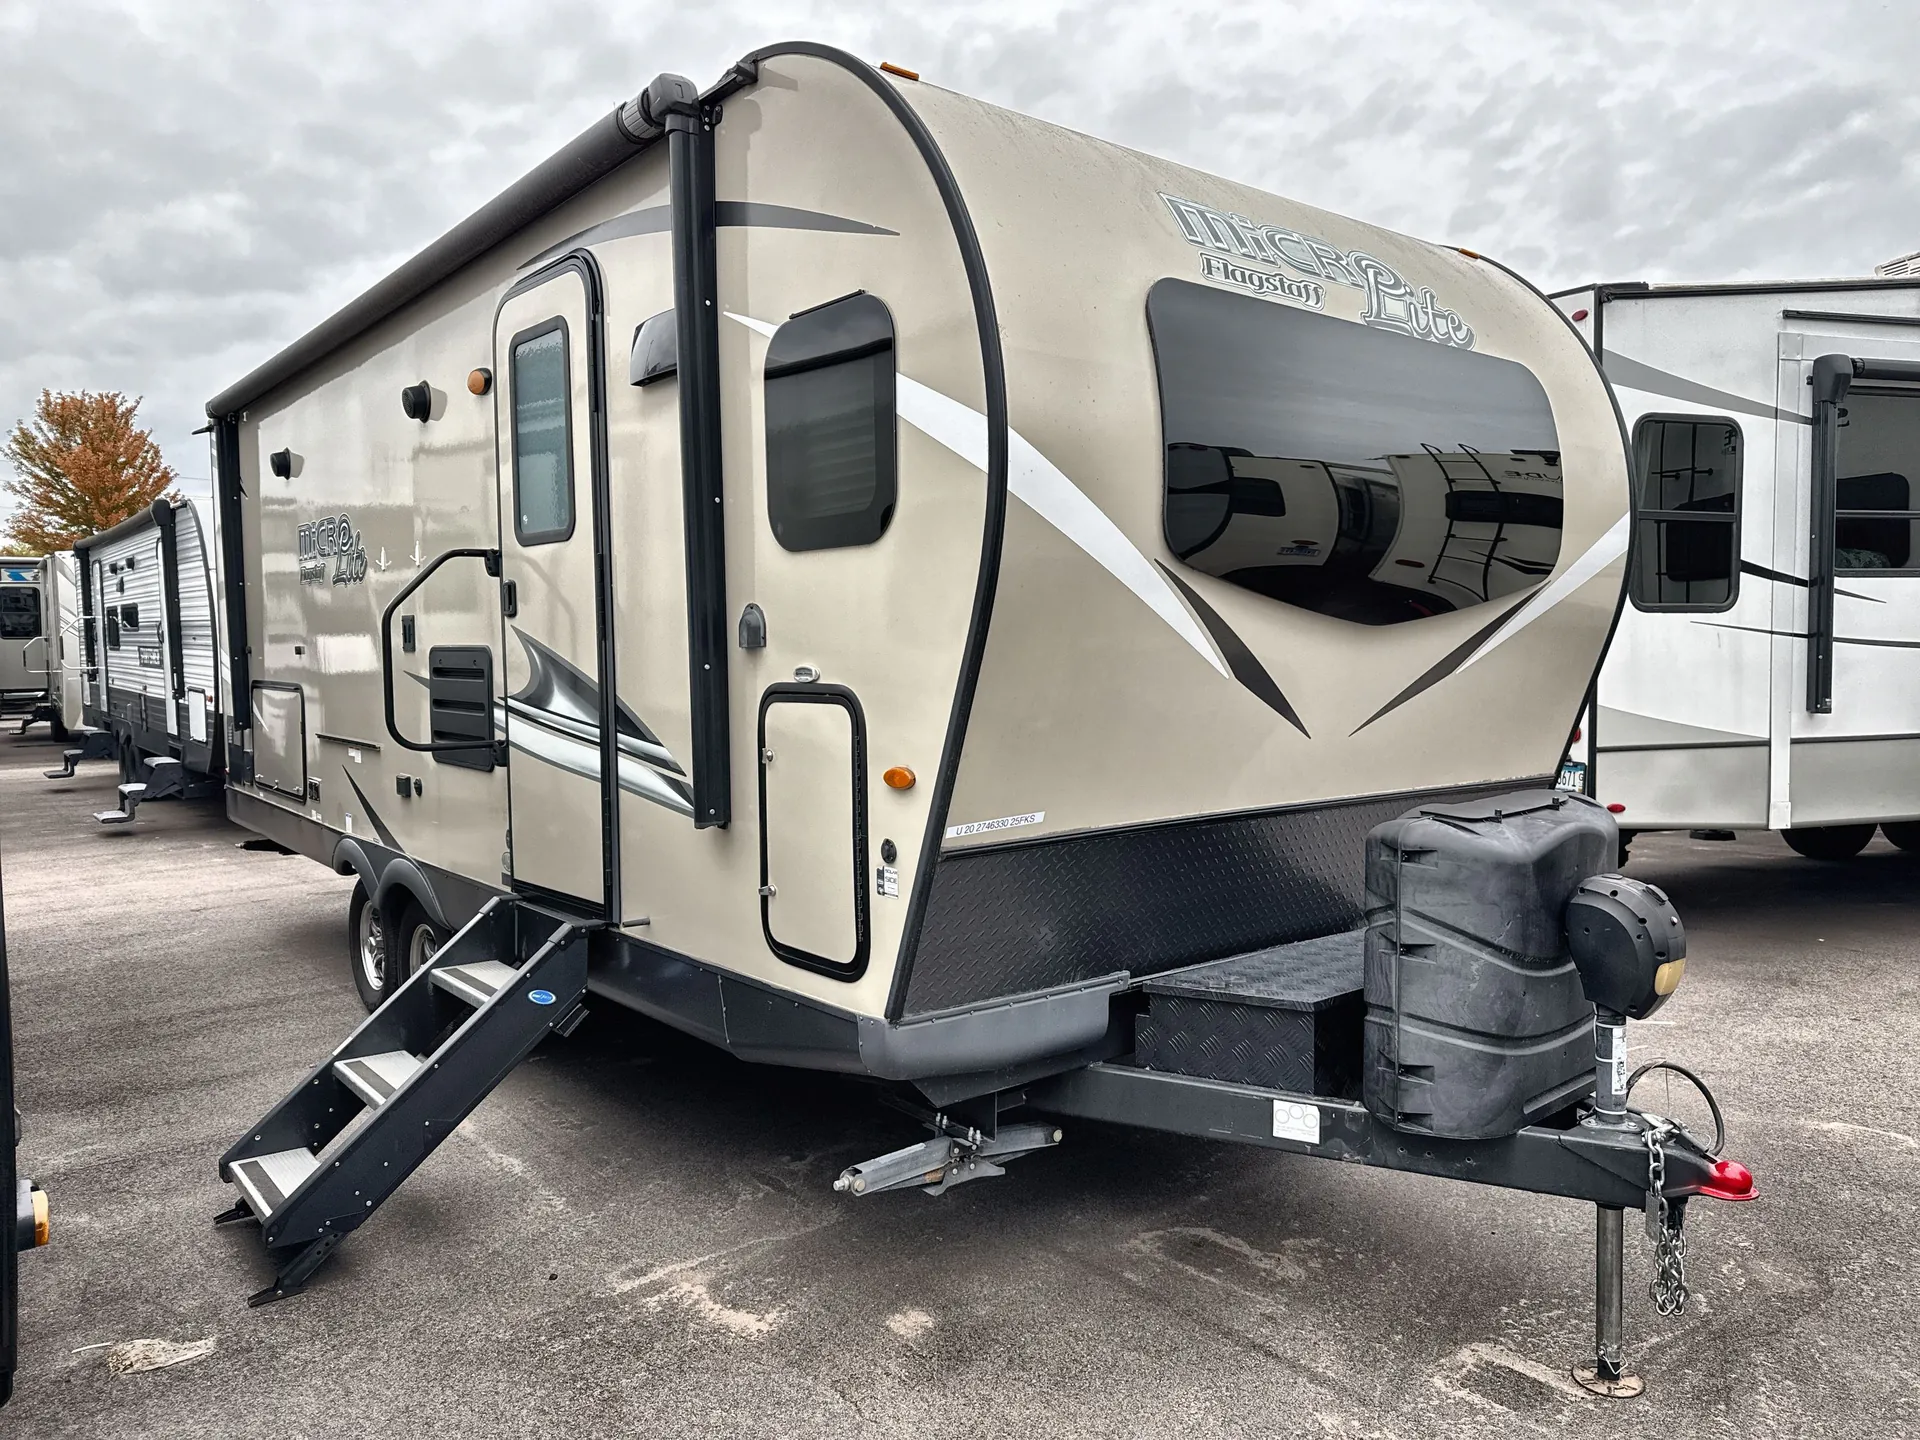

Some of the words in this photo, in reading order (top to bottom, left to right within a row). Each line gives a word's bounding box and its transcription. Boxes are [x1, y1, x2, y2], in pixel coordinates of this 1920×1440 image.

[1202, 253, 1325, 309] Flagstaff
[1359, 257, 1477, 350] Lite
[956, 827, 963, 835] U
[964, 825, 975, 834] 20
[976, 818, 1009, 832] 2746330
[1010, 814, 1036, 826] 25FKS
